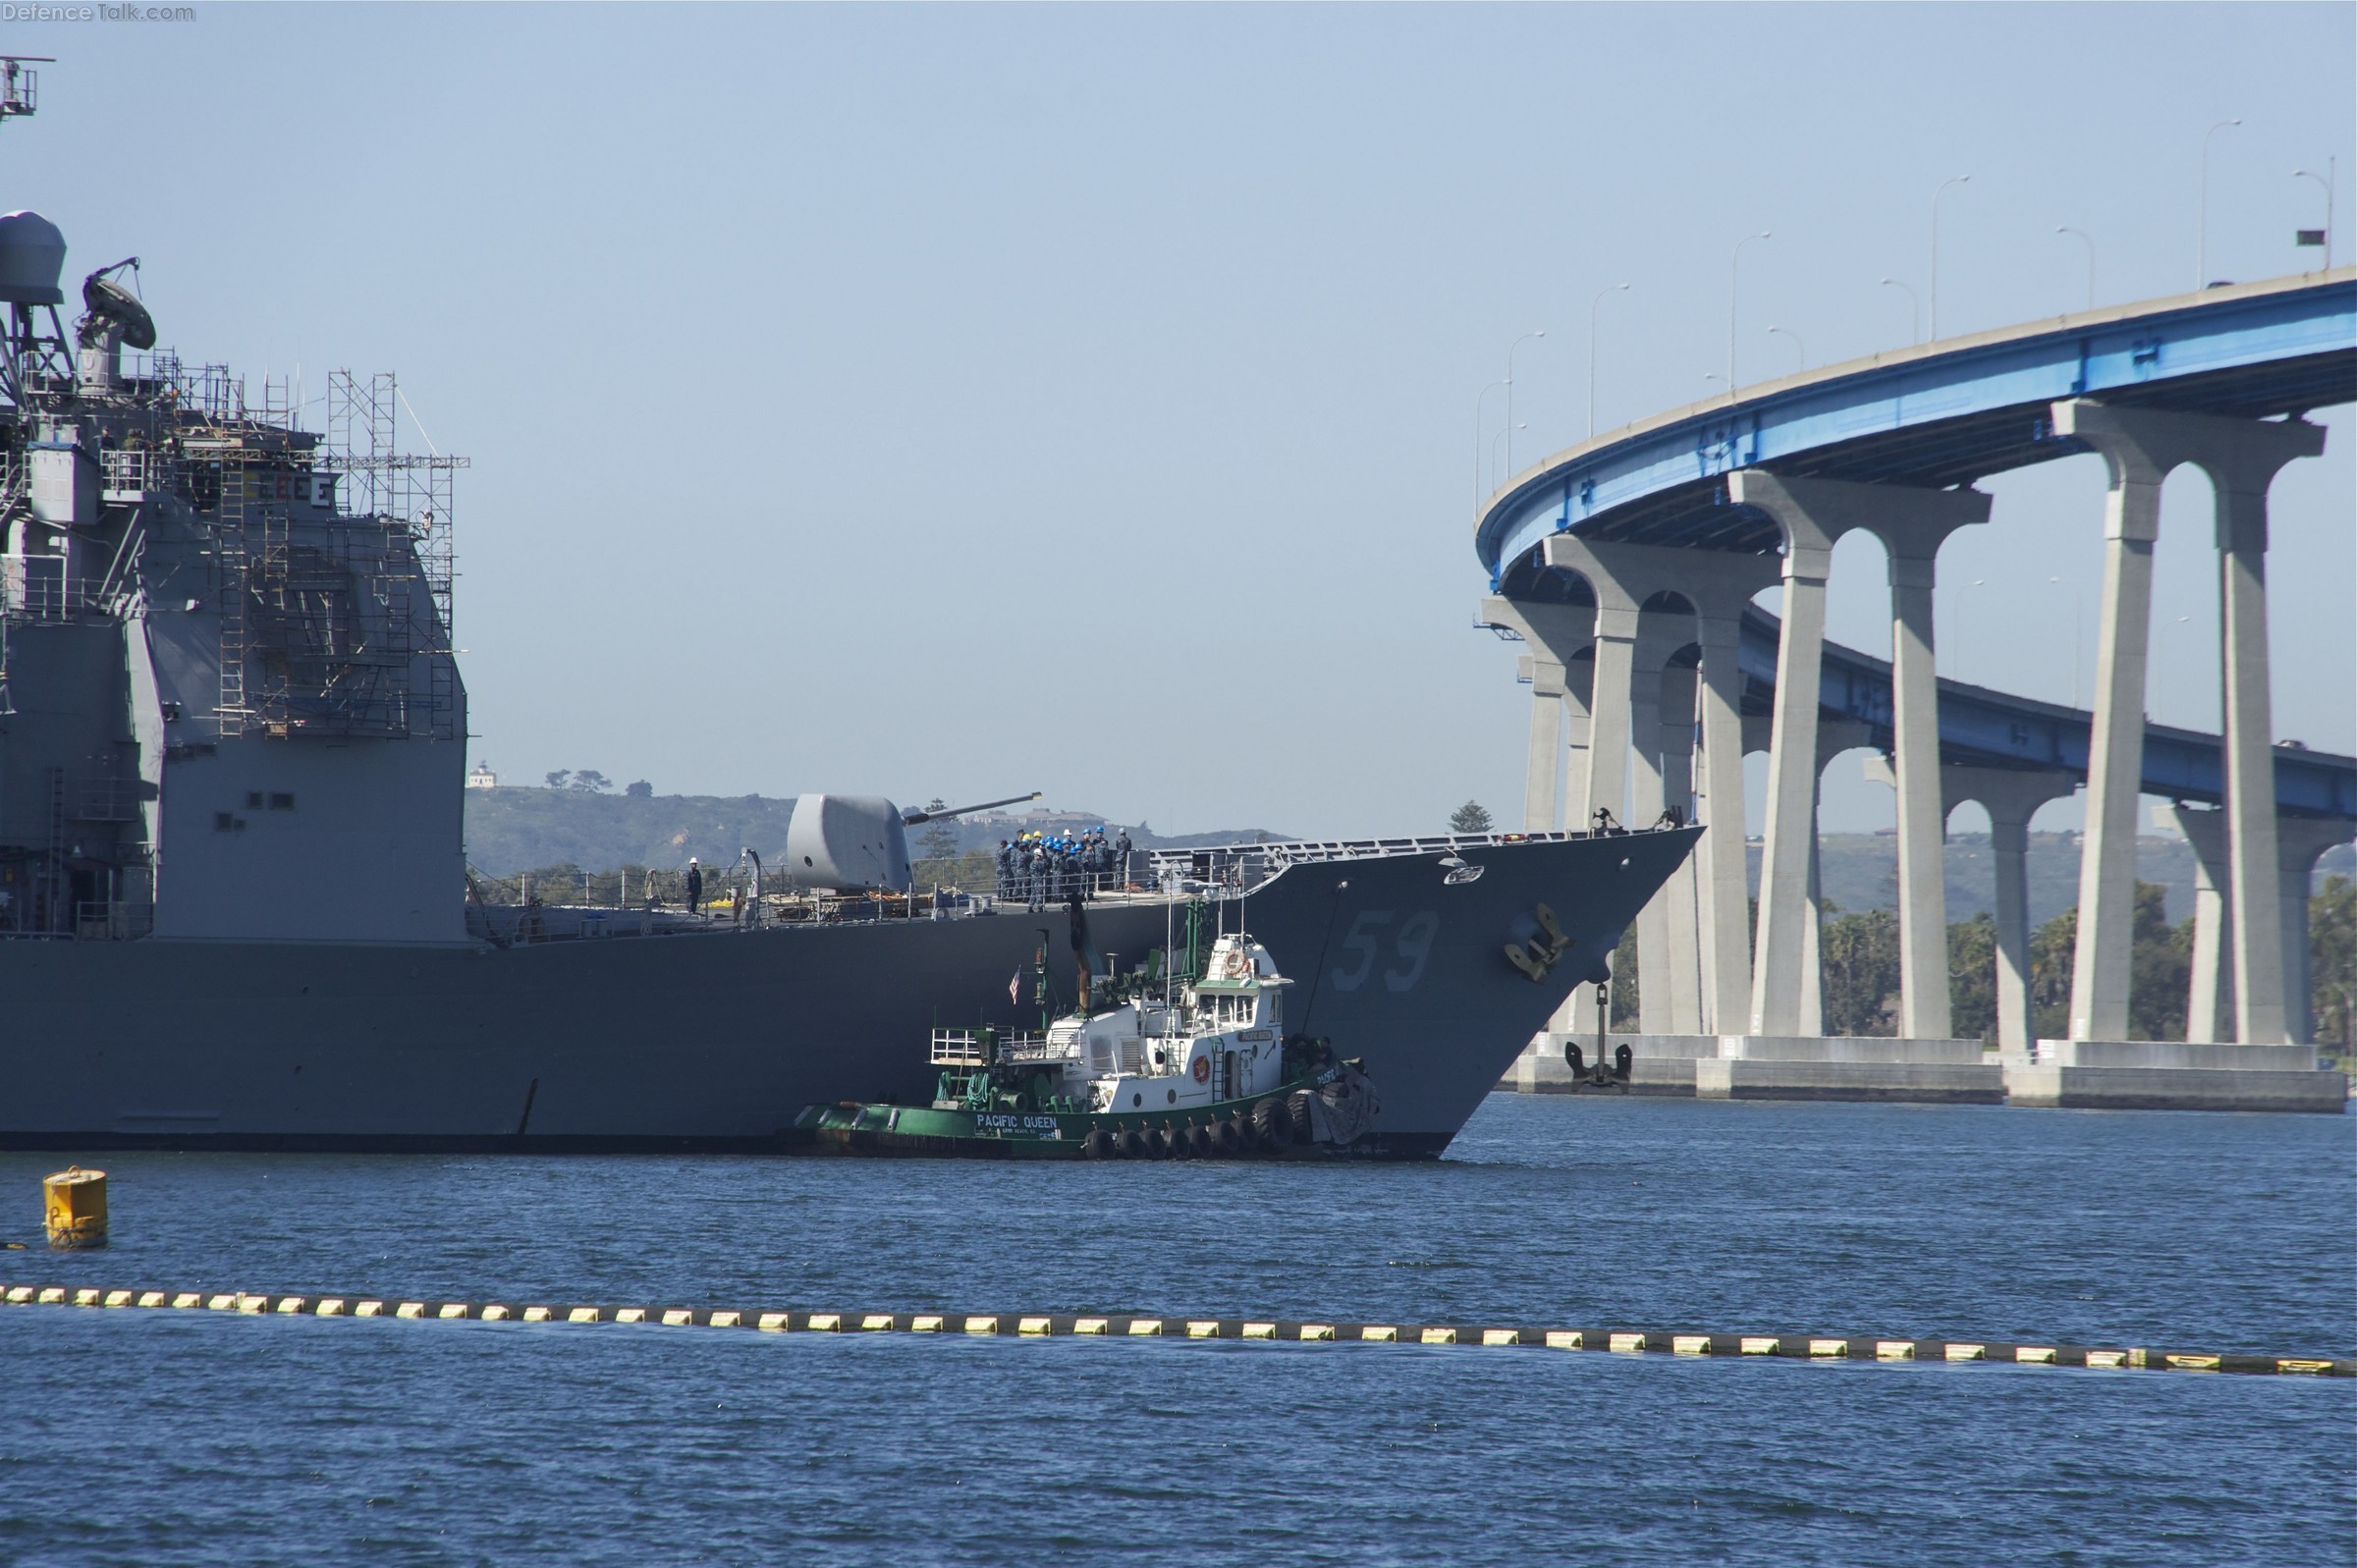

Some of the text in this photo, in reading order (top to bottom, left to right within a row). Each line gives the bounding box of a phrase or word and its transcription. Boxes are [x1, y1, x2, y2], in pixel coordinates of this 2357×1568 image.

[311, 476, 332, 507] E
[1331, 909, 1441, 992] 59
[976, 1114, 1057, 1128] PACIFIC QUEEN
